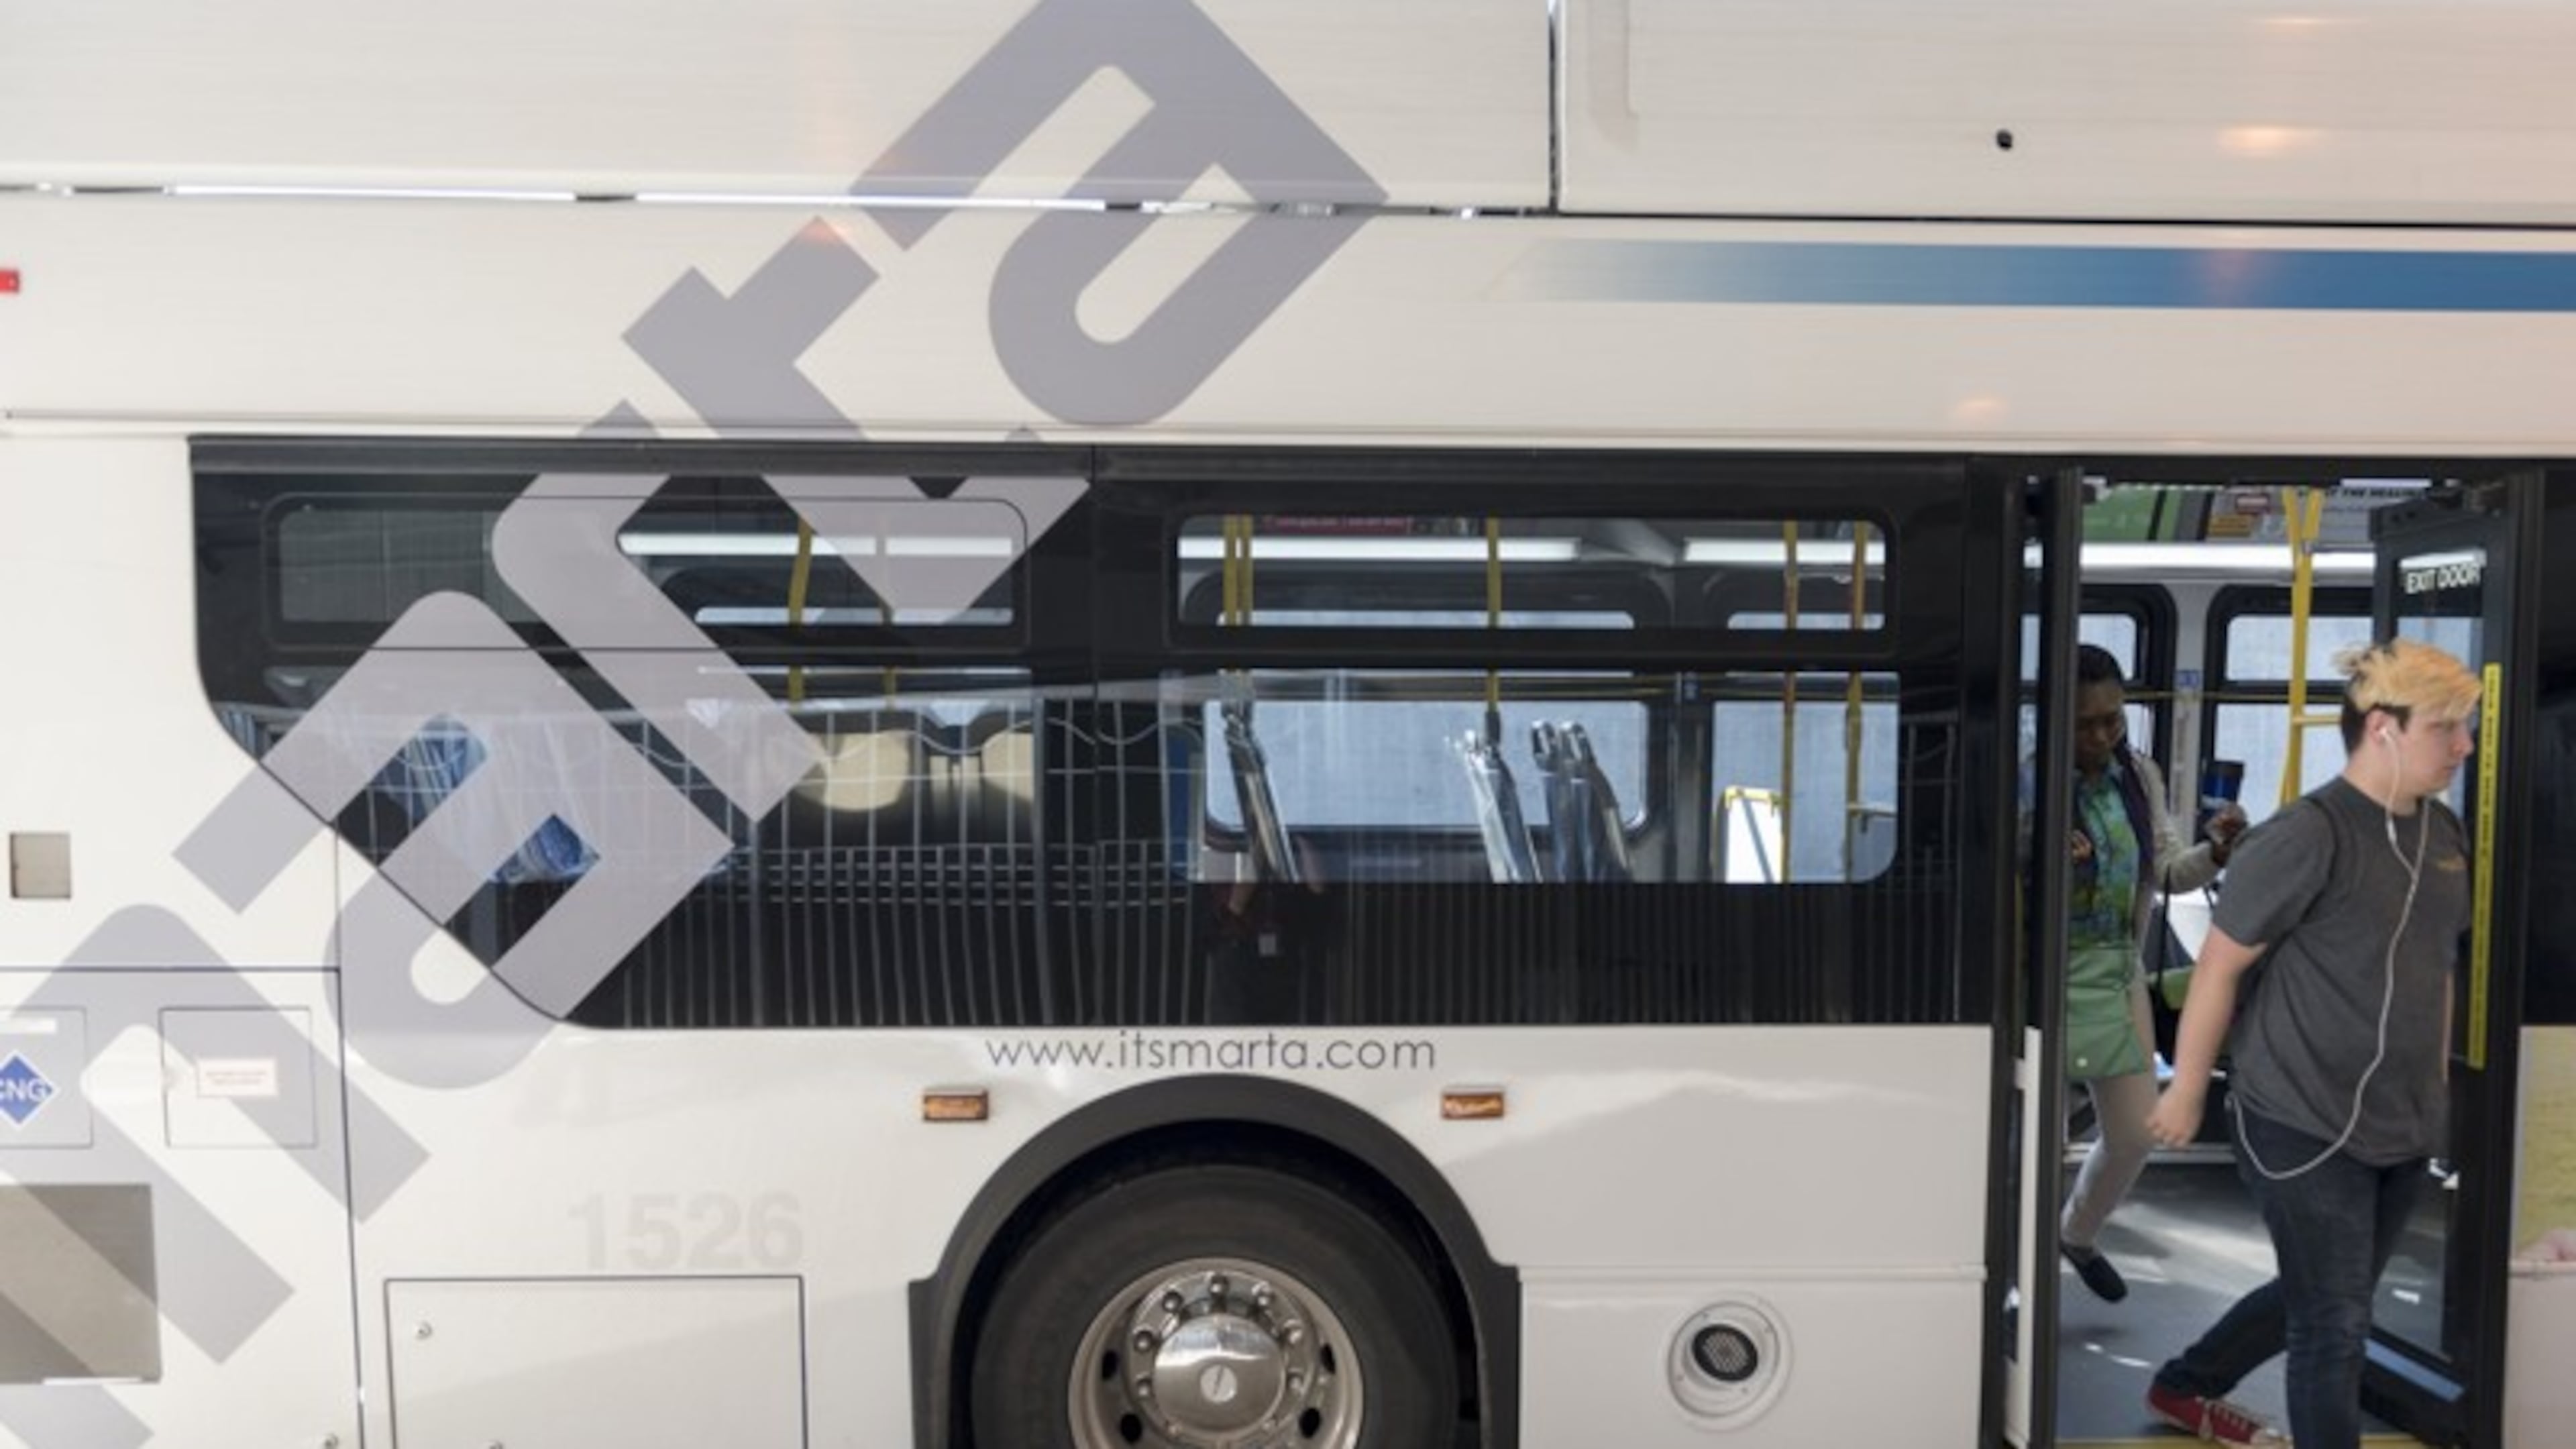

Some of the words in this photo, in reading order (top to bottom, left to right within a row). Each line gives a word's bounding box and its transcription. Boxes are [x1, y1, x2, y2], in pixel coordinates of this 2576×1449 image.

[2406, 570, 2436, 594] EXIT
[985, 1031, 1436, 1070] www.itsmarta.com
[0, 1077, 48, 1102] NG
[568, 1189, 803, 1270] 1526
